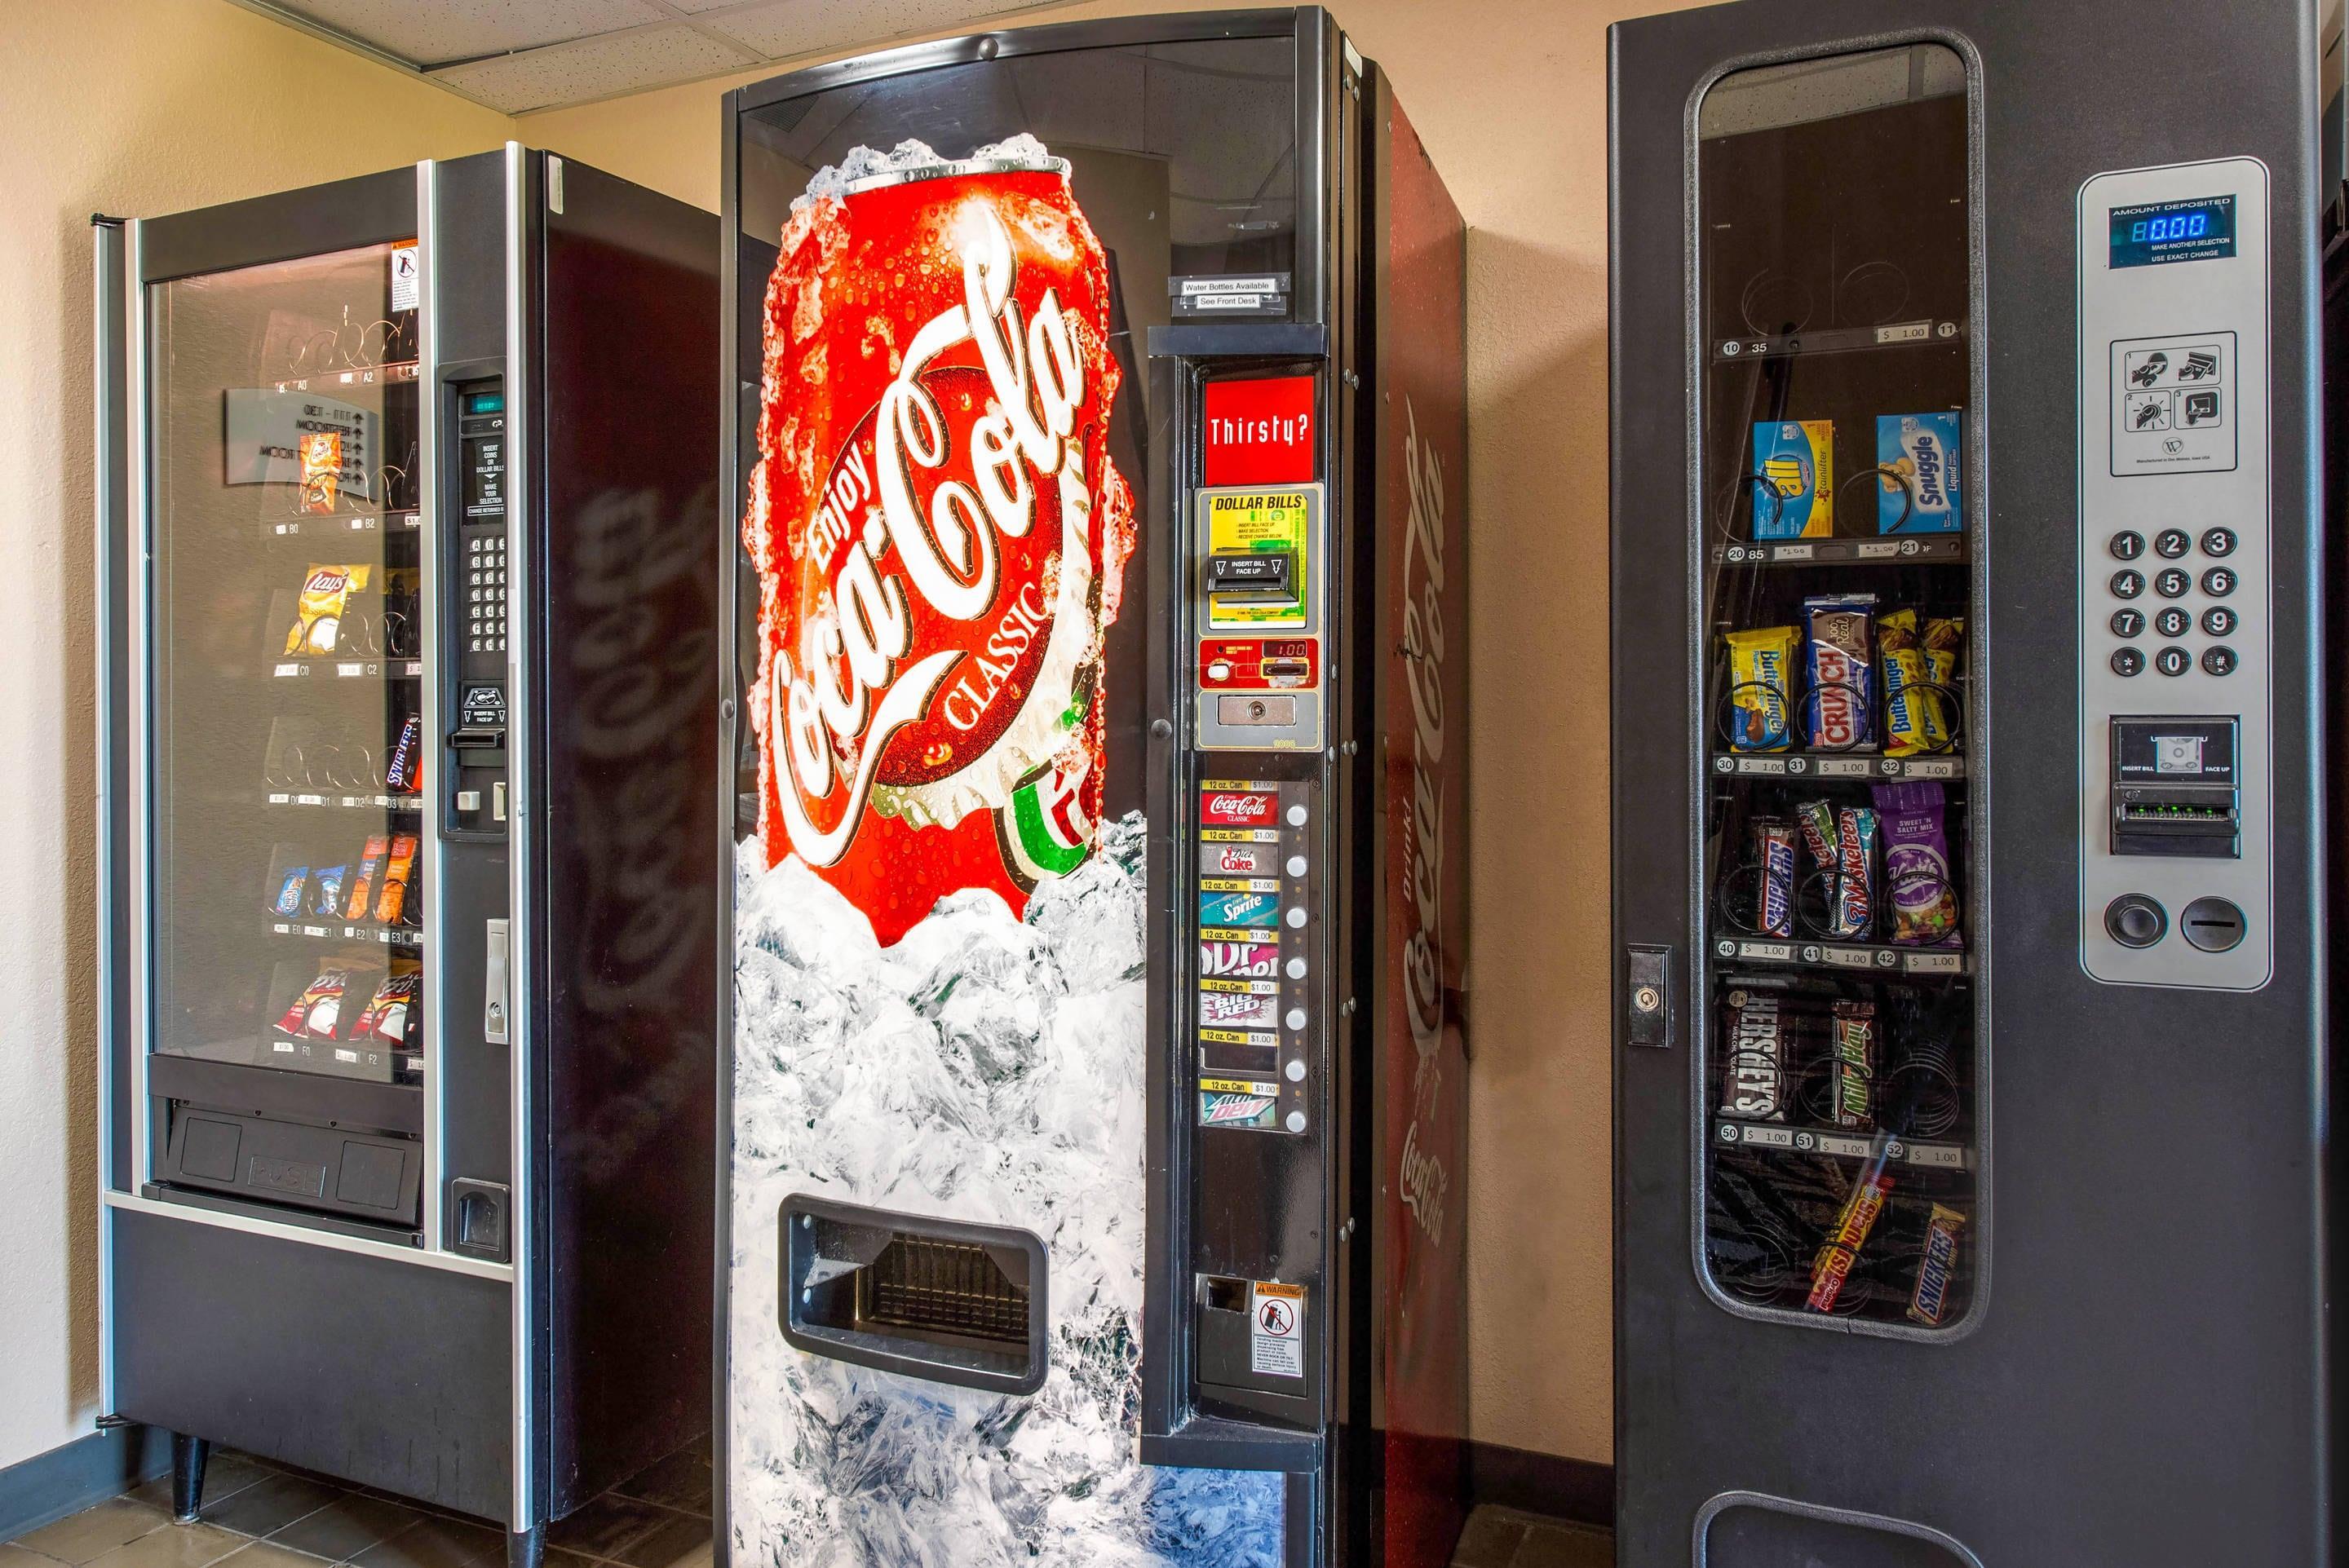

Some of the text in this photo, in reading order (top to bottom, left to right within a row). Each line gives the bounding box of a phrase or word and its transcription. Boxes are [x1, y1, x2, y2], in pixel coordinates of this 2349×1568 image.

[2112, 198, 2231, 216] AMOUNT DEPOSITED
[2169, 241, 2196, 249] ANOTHER
[2196, 237, 2230, 246] SELECTION
[2190, 250, 2219, 258] CHANGE
[1185, 284, 1207, 292] Water
[1236, 282, 1269, 290] Available
[1217, 297, 1236, 305] Front
[1238, 296, 1257, 304] Desk
[1902, 329, 1925, 338] 1.00
[1940, 325, 1953, 334] 11
[1725, 343, 1738, 352] 10
[1751, 343, 1767, 352] 35
[363, 372, 374, 382] A2
[298, 382, 307, 391] A0
[1210, 413, 1308, 446] Thirsty?
[1820, 450, 1828, 495] stainlifter
[1912, 436, 1944, 506] Snuggle
[1764, 459, 1803, 497] all
[1948, 466, 1960, 492] Liquid
[479, 497, 502, 505] SELECTION
[1215, 495, 1303, 510] DOLLAR BILLS
[807, 440, 871, 574] Enjoy
[289, 523, 299, 533] B0
[365, 518, 374, 528] B2
[771, 201, 1090, 869] Coca-Cola
[2121, 536, 2132, 554] 1
[2166, 534, 2180, 553] 2
[2211, 532, 2227, 551] 3
[1902, 543, 1917, 552] 21
[1729, 550, 1744, 559] 20
[1748, 550, 1764, 559] 85
[304, 572, 348, 593] Lay's
[2120, 575, 2134, 594] 4
[2165, 574, 2180, 594] 5
[2211, 572, 2227, 592] 6
[2121, 614, 2134, 633] 7
[2166, 612, 2180, 632] 8
[2211, 612, 2227, 631] 9
[1835, 617, 1851, 645] Real
[944, 581, 1052, 731] CLASSIC
[2167, 652, 2180, 672] 0
[299, 665, 309, 676] C0
[367, 665, 378, 675] C2
[1817, 649, 1851, 744] CRUNCH
[1404, 394, 1444, 1060] Coca-Cola
[1719, 760, 1732, 770] 30
[1763, 762, 1784, 772] 1.00
[1790, 761, 1803, 770] 31
[1842, 763, 1864, 772] 1.00
[1883, 762, 1898, 771] 32
[1926, 765, 1948, 775] 1.00
[355, 797, 365, 807] D2
[387, 798, 397, 809] D3
[1210, 794, 1268, 815] Coca-Cola
[1254, 832, 1274, 840] $1.00
[1232, 847, 1254, 859] Diet
[1402, 795, 1412, 903] Drink!
[1221, 856, 1253, 871] Coke
[1253, 881, 1273, 889] $1.00
[1223, 894, 1263, 923] Sprite
[292, 925, 301, 934] E0
[356, 930, 365, 939] E2
[1226, 931, 1239, 939] Can
[392, 932, 400, 943] E3
[1720, 944, 1734, 953] 40
[1763, 947, 1785, 956] 1.00
[1805, 949, 1818, 958] 41
[1214, 942, 1259, 975] Dr
[1845, 954, 1866, 964] 1.00
[1879, 953, 1894, 963] 42
[1931, 957, 1955, 966] 1.00
[1210, 982, 1271, 992] 12 Can $1.00
[1214, 994, 1253, 1009] BIG
[1217, 1000, 1260, 1019] RED
[1206, 1031, 1271, 1043] 12 Can $1.00
[1840, 1023, 1872, 1065] Way
[302, 1045, 310, 1056] F0
[1736, 998, 1779, 1111] HERSHEY'S
[368, 1053, 378, 1064] F2
[1211, 1082, 1275, 1093] 12 Can $1.00
[1723, 1129, 1736, 1137] 50
[1767, 1133, 1787, 1142] 1.00
[1798, 1137, 1811, 1146] 51
[1842, 1145, 1865, 1155] 1.00
[1887, 1146, 1901, 1155] 52
[1935, 1153, 1957, 1163] 1.00
[253, 1157, 321, 1192] PUSH
[1400, 1120, 1448, 1248] Coca-Cola
[1266, 1286, 1300, 1296] WARNING
[1820, 1279, 1840, 1311] Original
